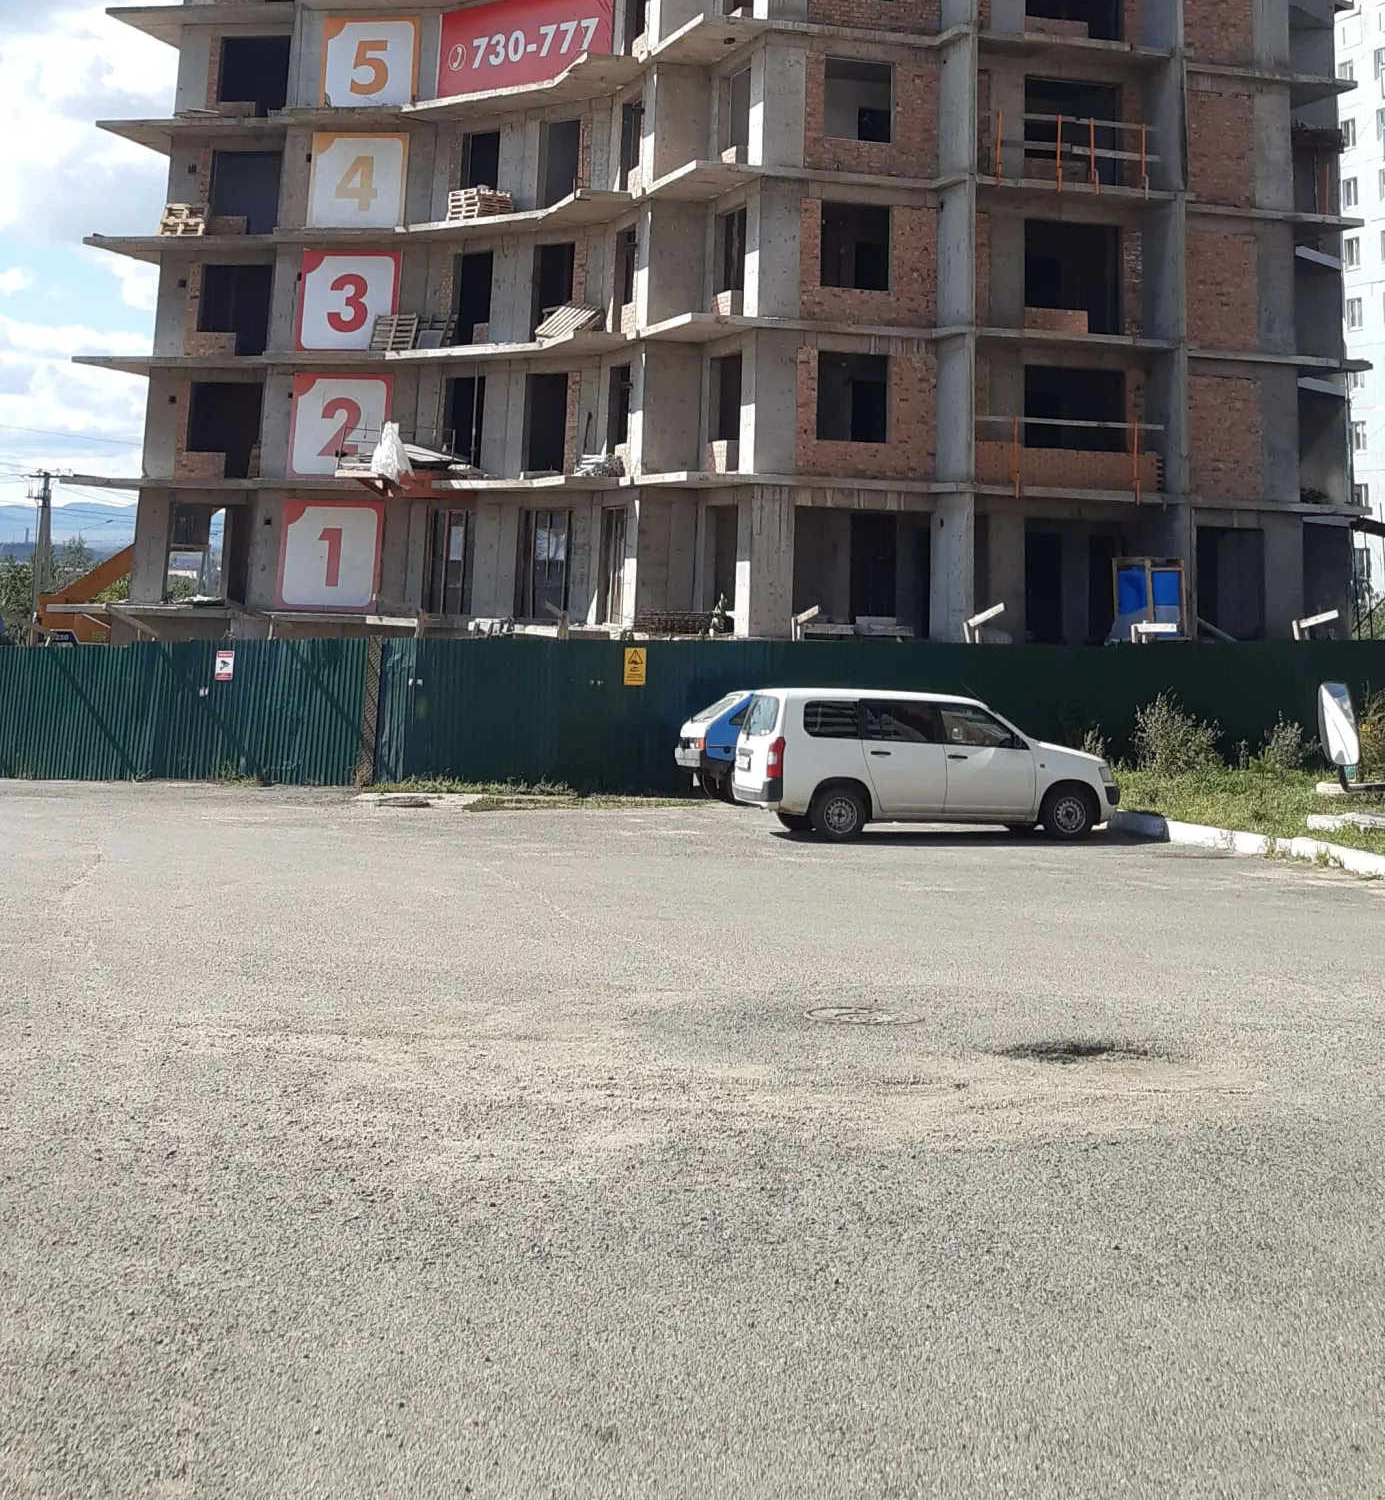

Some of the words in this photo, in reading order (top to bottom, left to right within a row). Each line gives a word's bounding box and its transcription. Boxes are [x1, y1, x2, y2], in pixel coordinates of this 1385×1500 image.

[350, 41, 388, 95] 5
[471, 17, 599, 69] 730-777
[336, 156, 377, 211] 4
[327, 274, 368, 332] 3
[317, 397, 361, 457] 2
[318, 527, 343, 587] 1
